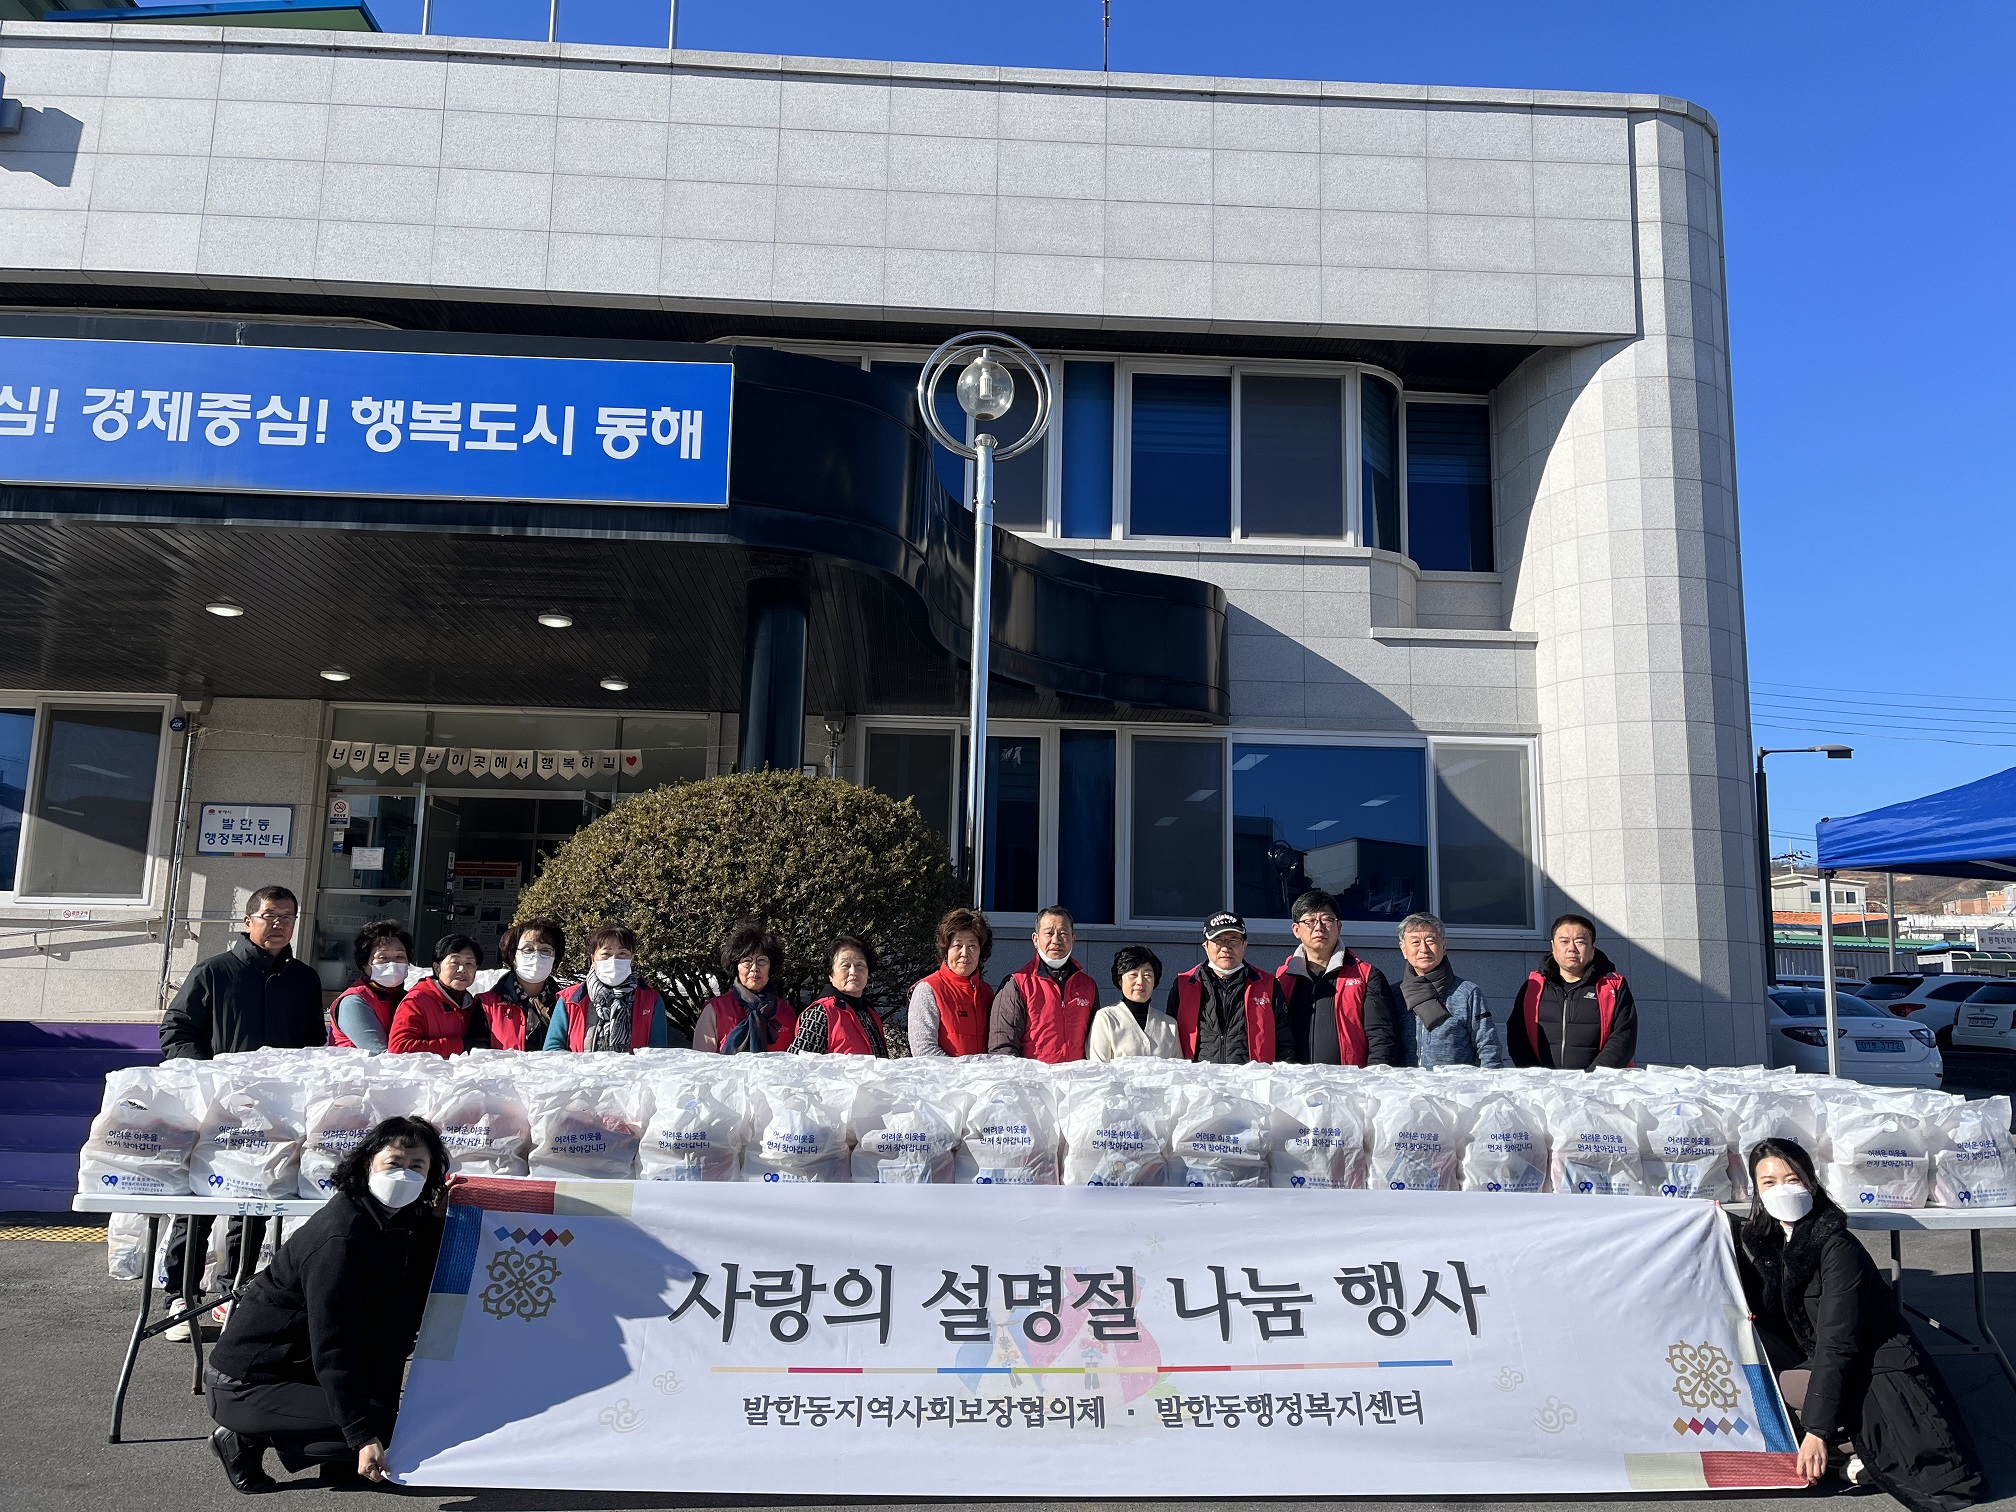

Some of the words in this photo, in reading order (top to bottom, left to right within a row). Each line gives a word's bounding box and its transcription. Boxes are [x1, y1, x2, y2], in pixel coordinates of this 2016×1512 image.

[82, 388, 329, 446] 경제중심!
[351, 396, 575, 456] 행복도시
[595, 406, 703, 460] 동해
[332, 747, 367, 763] 너의
[377, 751, 411, 765] 모든
[425, 752, 440, 765] 날
[452, 754, 528, 770] 이곳에서
[541, 756, 616, 770] 행복하길
[222, 818, 270, 832] 발한동
[204, 832, 284, 847] 행정복지센터
[219, 1126, 240, 1135] 어려운
[323, 1130, 347, 1139] 어려운
[446, 1126, 468, 1135] 어려운
[983, 1126, 1005, 1134] 어려운
[1096, 1129, 1118, 1139] 어려운
[109, 1130, 131, 1140] 어려운
[554, 1134, 578, 1144] 어려운
[661, 1131, 682, 1140] 어려운
[881, 1133, 903, 1141] 어려운
[1195, 1132, 1216, 1142] 어려운
[1398, 1131, 1419, 1140] 어려운
[1490, 1132, 1511, 1141] 어려운
[1580, 1133, 1601, 1142] 어려운
[1667, 1136, 1690, 1145] 어려운
[1957, 1141, 1979, 1150] 어려운
[1867, 1149, 1888, 1158] 어려운
[668, 1262, 893, 1345] 사랑의
[921, 1264, 1139, 1344] 설명절
[1170, 1264, 1314, 1342] 나눔
[1334, 1260, 1487, 1337] 행사
[743, 1395, 1107, 1431] 발한동지역사회보장협의체
[1154, 1390, 1425, 1430] 발한동행정복지센터
